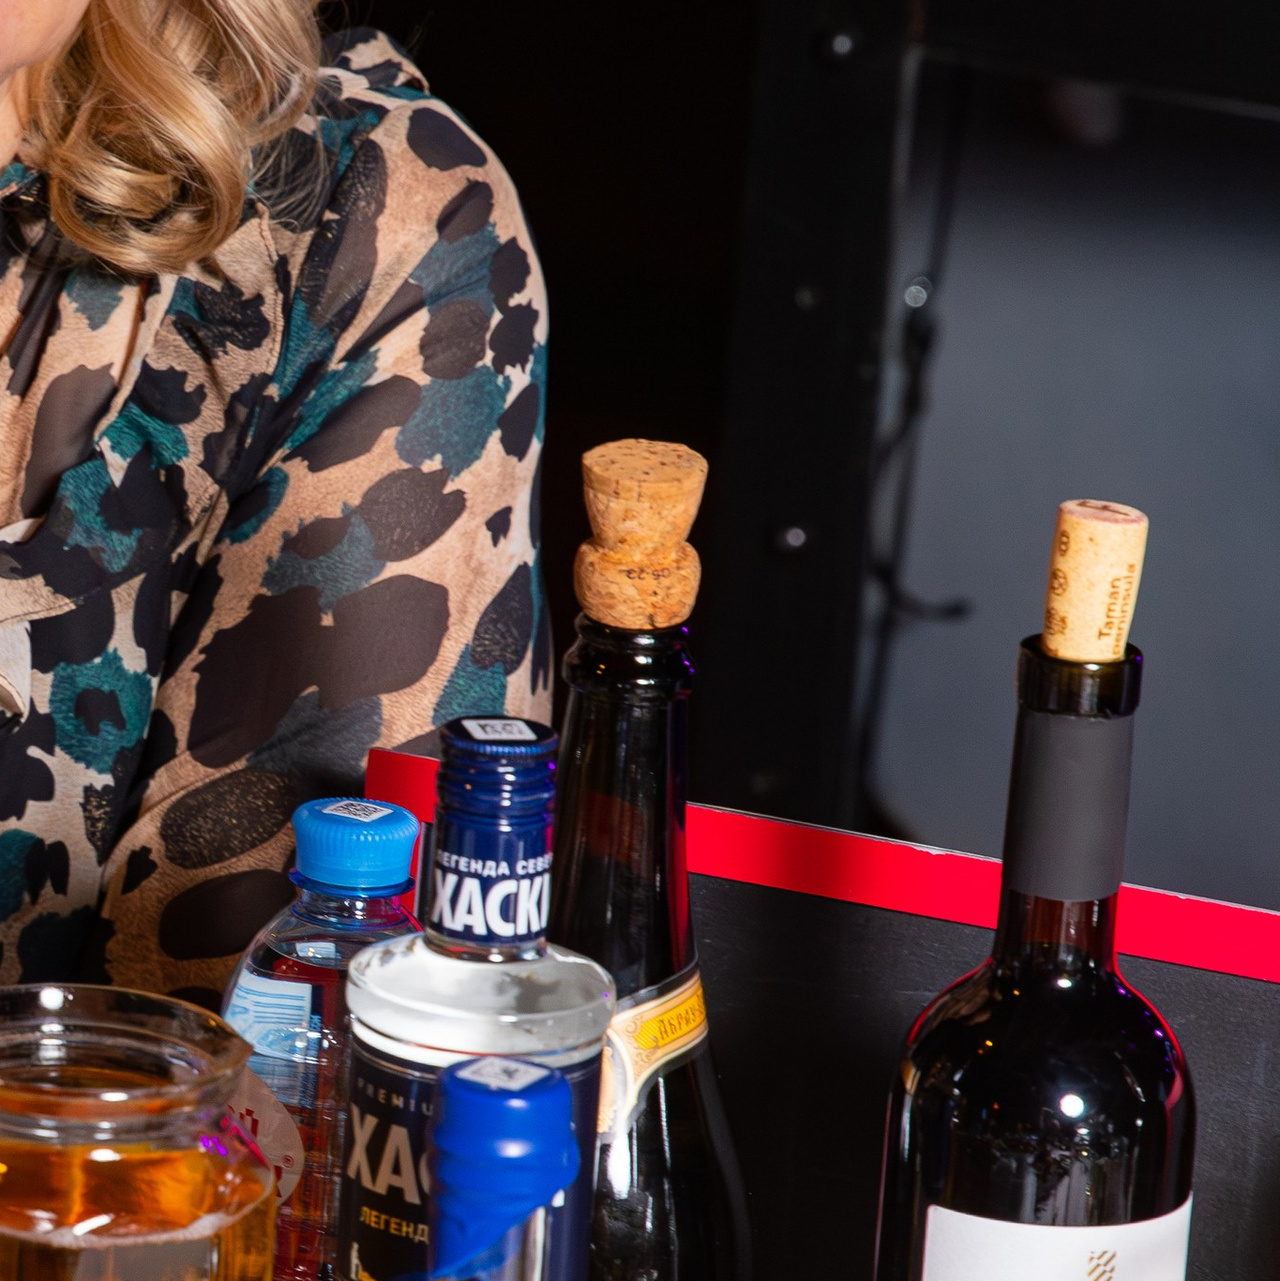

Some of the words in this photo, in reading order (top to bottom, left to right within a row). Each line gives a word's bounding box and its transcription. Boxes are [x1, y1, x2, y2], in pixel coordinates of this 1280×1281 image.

[1098, 577, 1122, 641] Taman
[357, 1077, 434, 1116] PREMIU
[360, 1205, 430, 1245] ЛЕГЕНД
